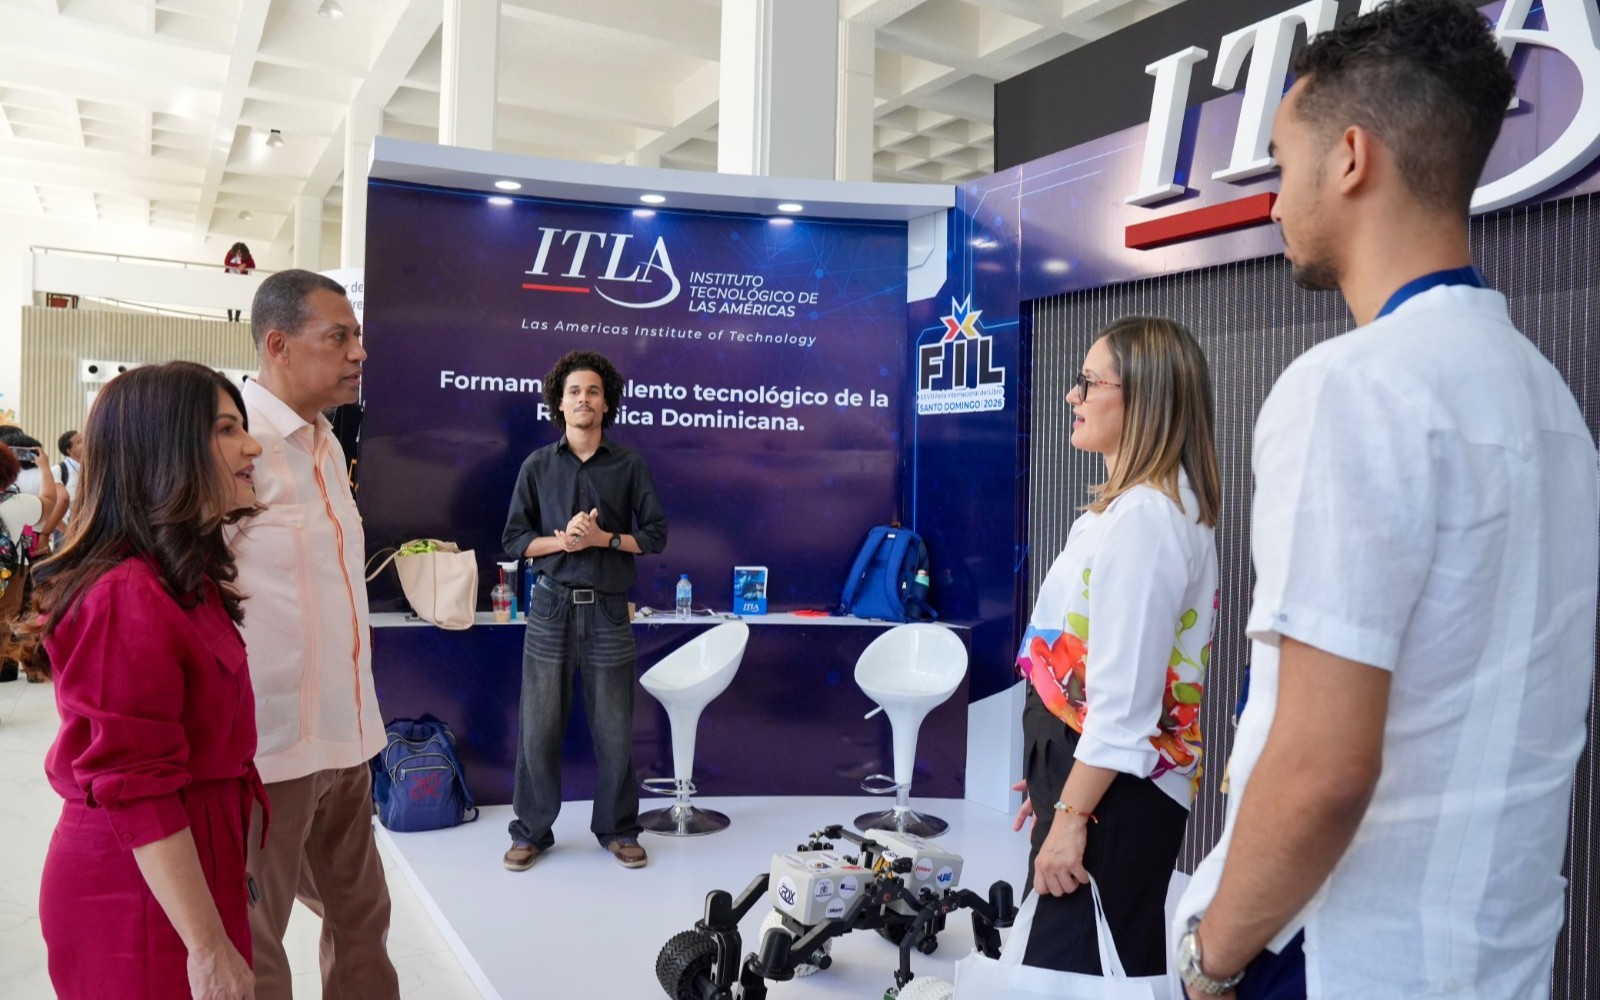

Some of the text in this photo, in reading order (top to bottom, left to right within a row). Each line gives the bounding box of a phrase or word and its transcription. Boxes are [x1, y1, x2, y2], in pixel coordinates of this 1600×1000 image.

[1125, 0, 1600, 216] ITA
[525, 227, 681, 309] ITLA
[689, 271, 764, 287] INSTITUTO
[689, 286, 819, 304] TECNOLÓGICO DE
[688, 300, 796, 318] LAS AMÉRICAS
[521, 318, 817, 347] Las Americas Institute of Technology
[919, 337, 1005, 390] FIL
[440, 370, 542, 393] Formam
[693, 383, 829, 408] tecnológico
[834, 388, 863, 407] de
[869, 389, 889, 408] la
[920, 399, 1003, 412] SANTO DOMINGO 2026
[661, 408, 805, 431] Dominicana.
